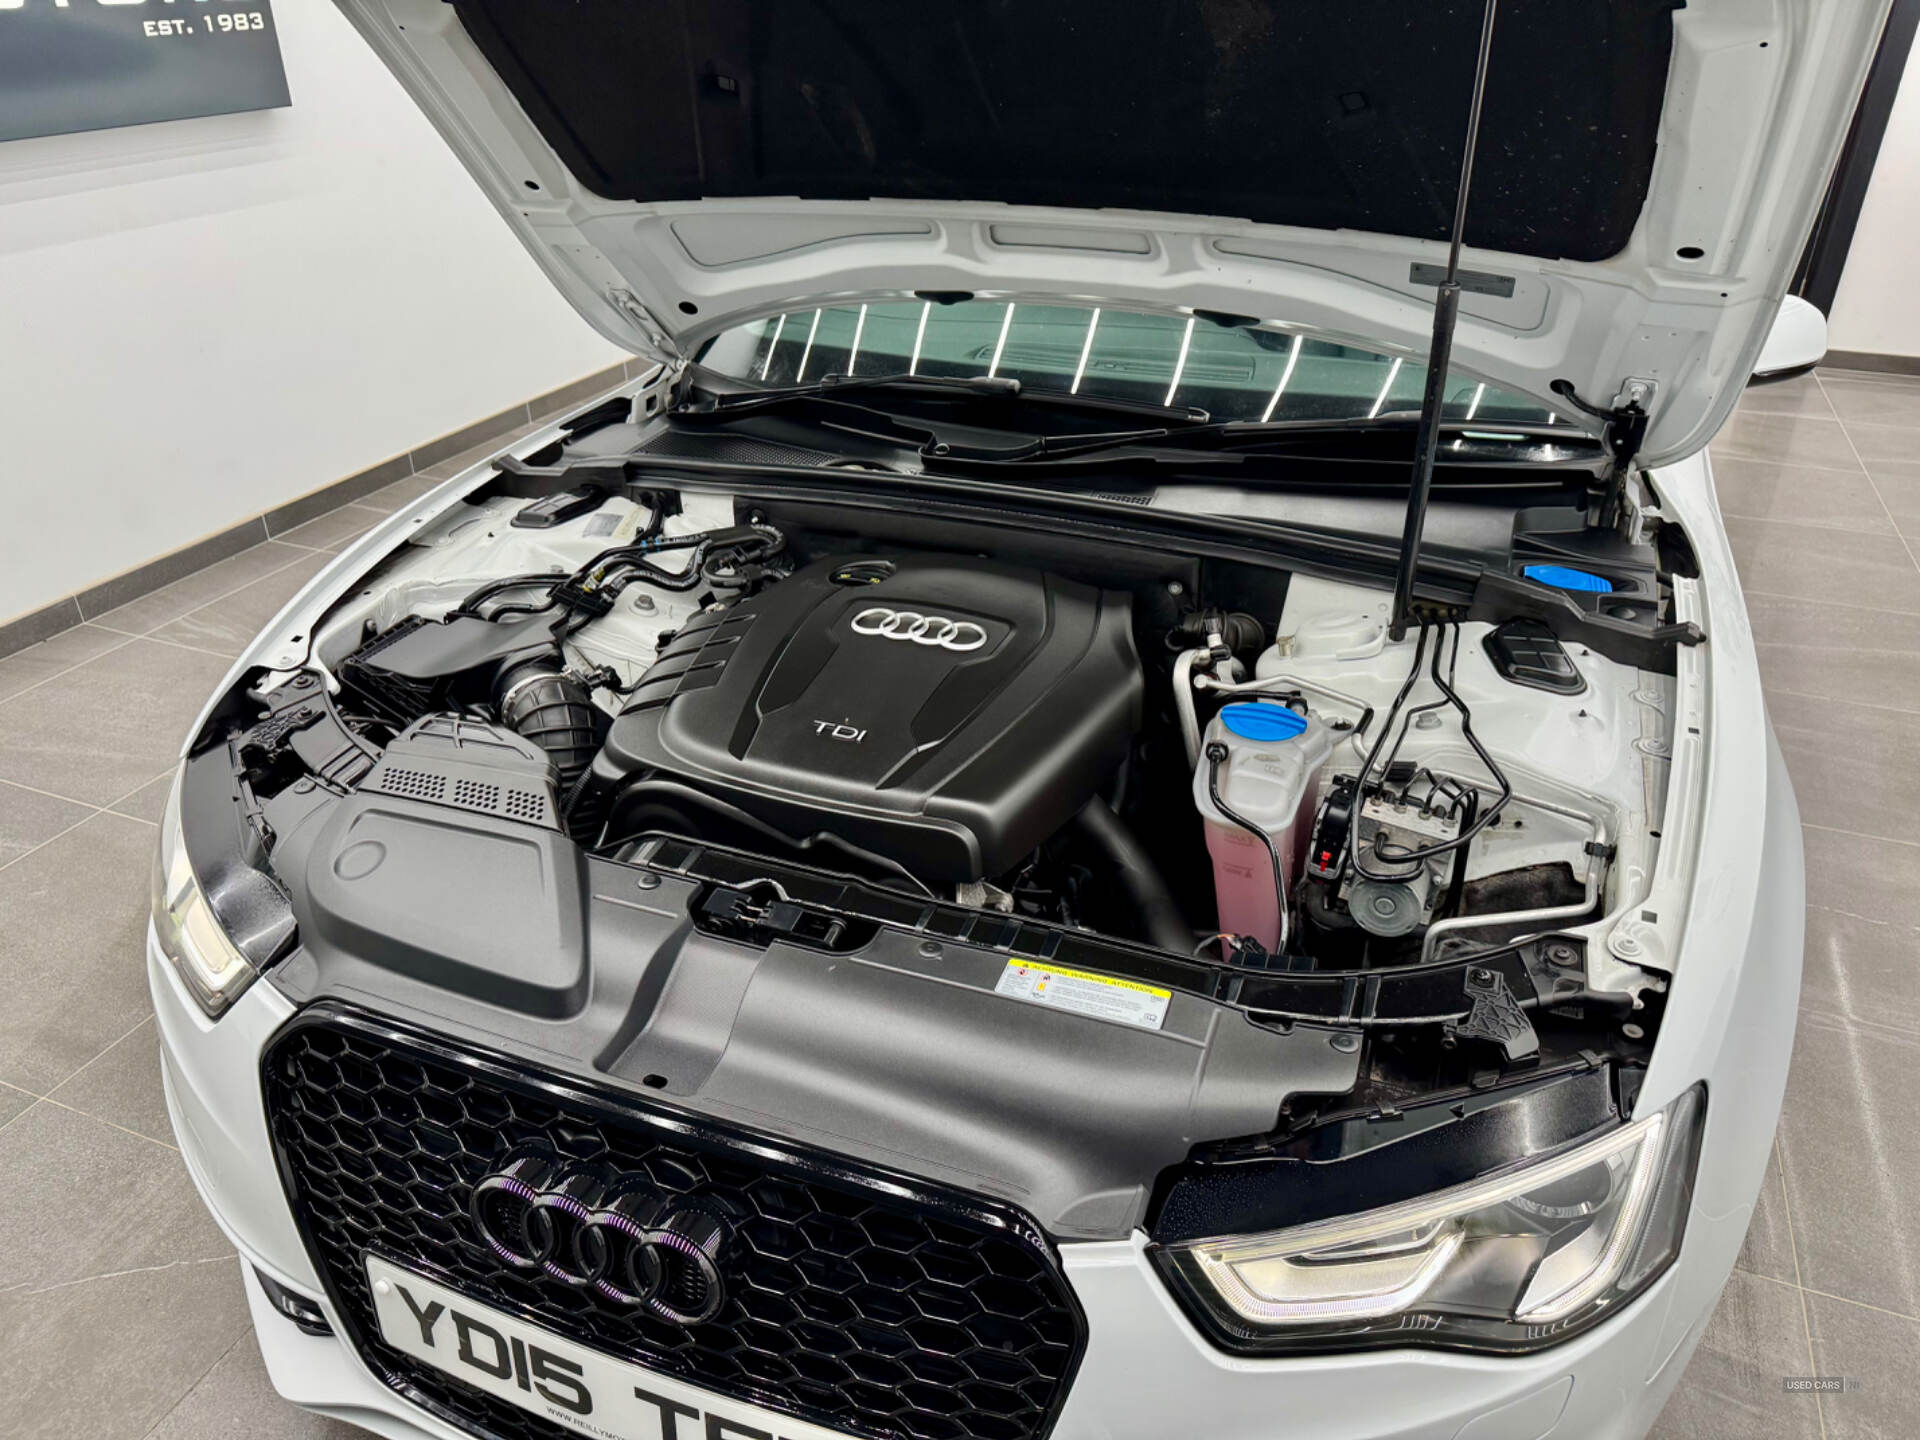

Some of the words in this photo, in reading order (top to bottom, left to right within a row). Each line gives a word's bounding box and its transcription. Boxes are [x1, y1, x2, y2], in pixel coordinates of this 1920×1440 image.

[143, 19, 194, 37] EST.
[203, 12, 265, 33] 1983
[813, 719, 868, 742] TDI
[394, 1283, 594, 1415] YD15
